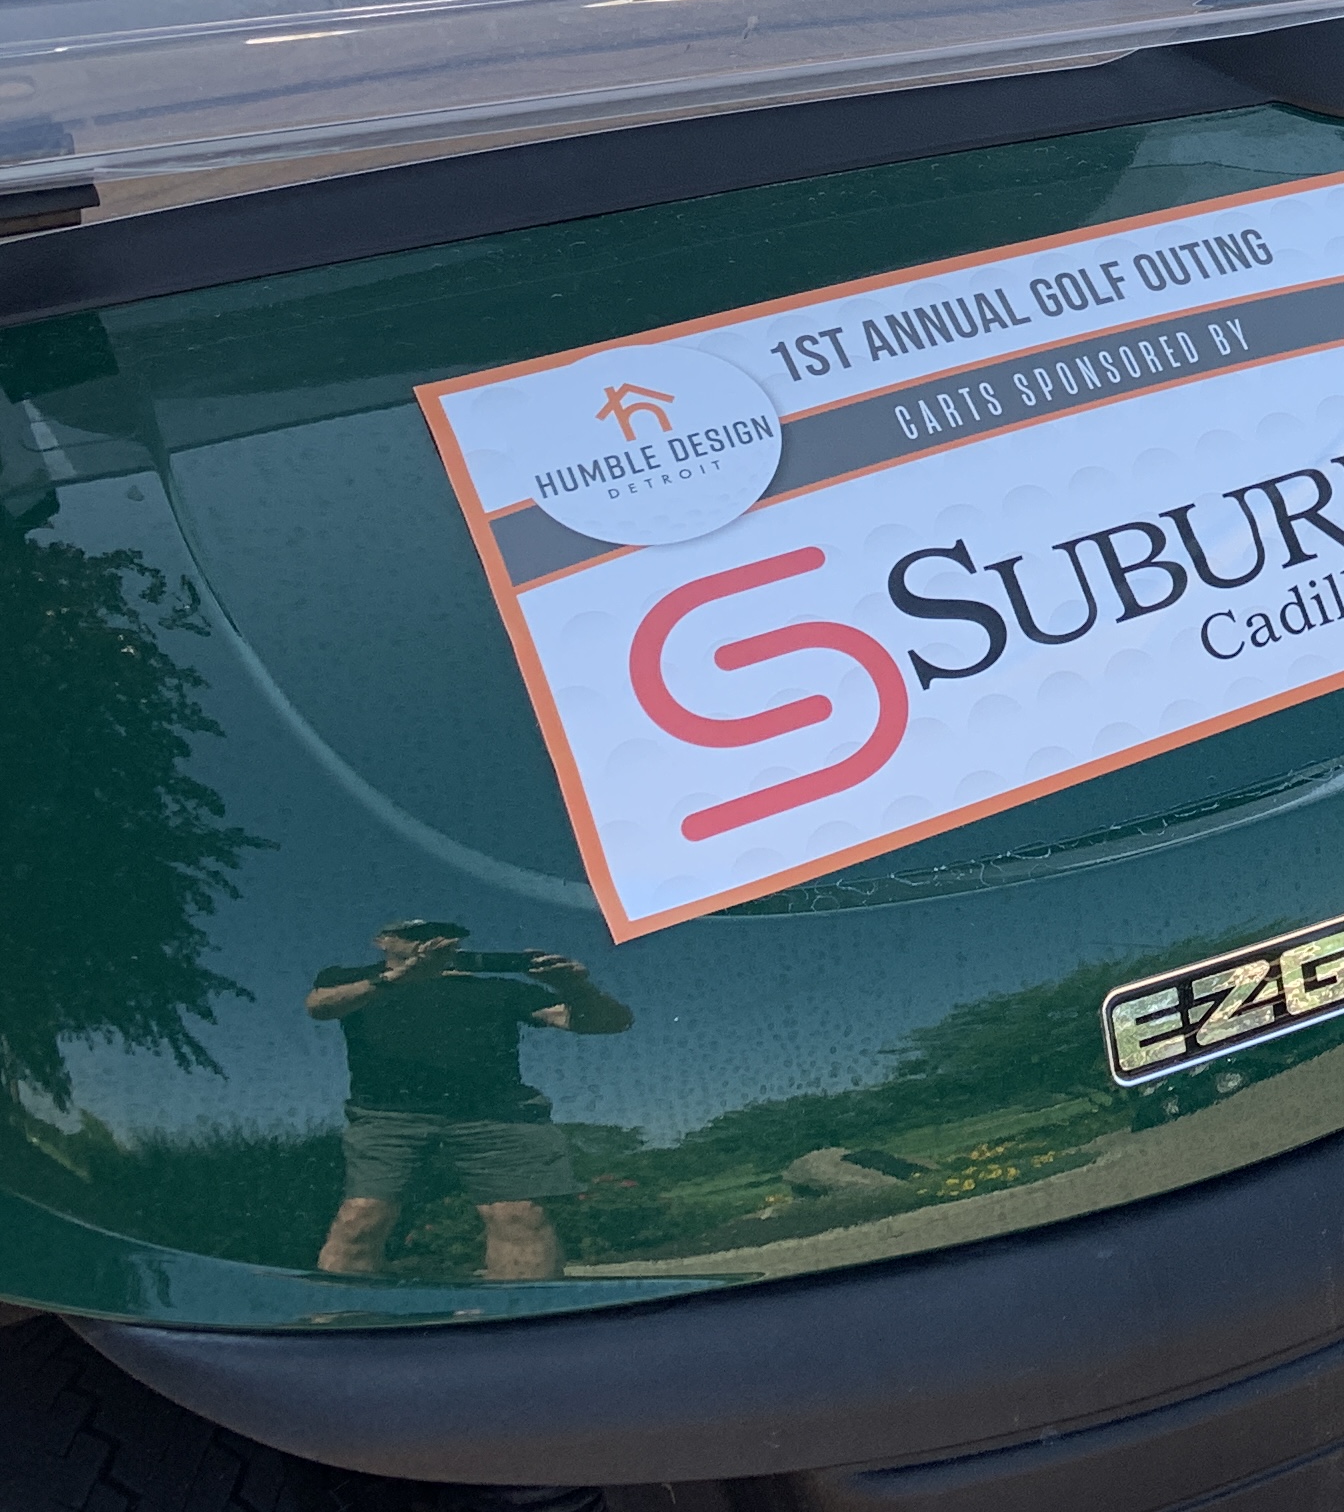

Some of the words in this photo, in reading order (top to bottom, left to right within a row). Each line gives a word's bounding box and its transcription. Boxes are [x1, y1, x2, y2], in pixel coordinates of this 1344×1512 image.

[770, 326, 853, 382] 1ST
[861, 287, 1031, 362] ANNUAL
[1028, 261, 1127, 318] GOLF
[1132, 228, 1274, 292] OUTING
[895, 381, 1003, 441] CARTS
[1013, 330, 1200, 407] SPONSORED
[1207, 318, 1251, 356] BY
[534, 445, 661, 499] HUMBLE
[667, 415, 774, 463] DESIGN
[607, 459, 721, 500] DETROIT
